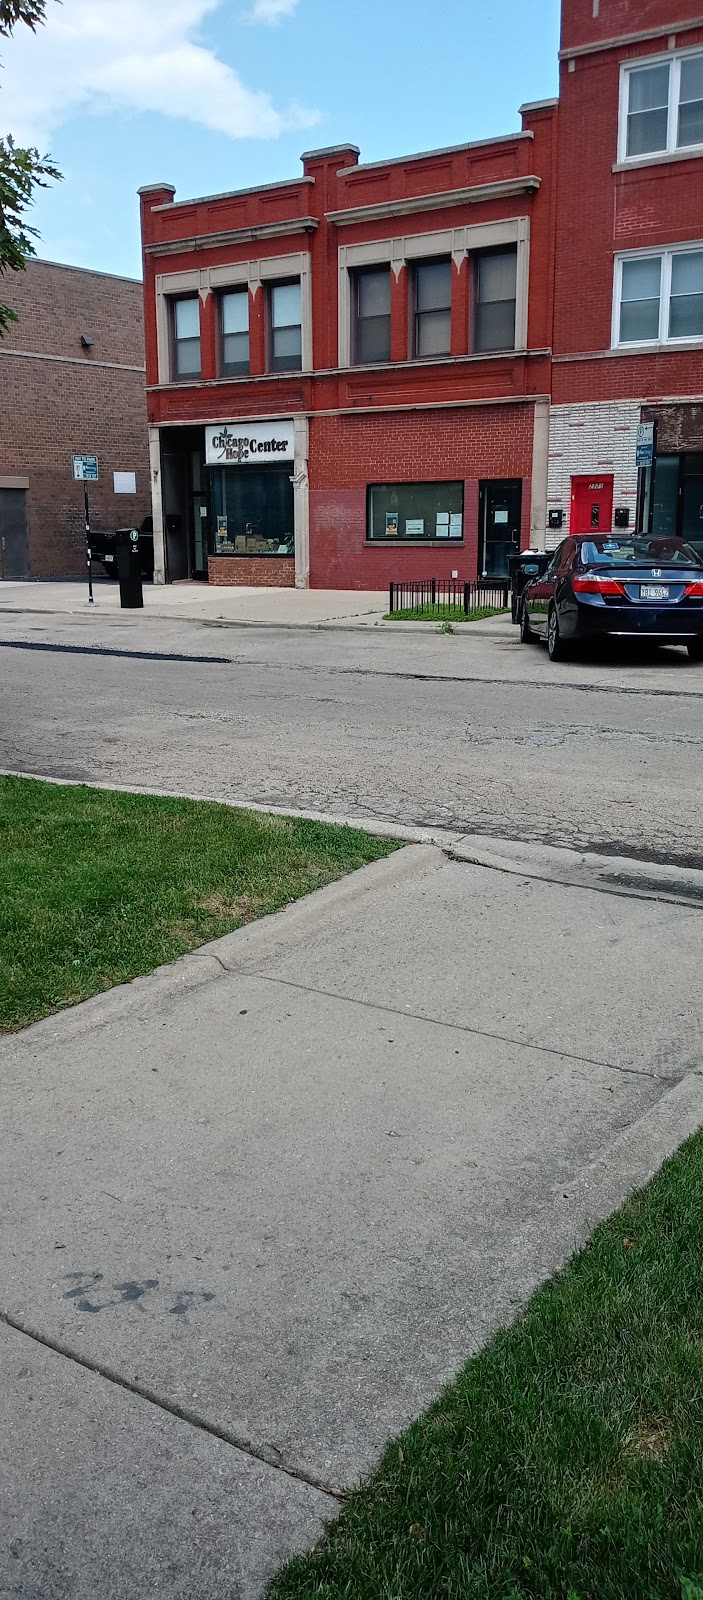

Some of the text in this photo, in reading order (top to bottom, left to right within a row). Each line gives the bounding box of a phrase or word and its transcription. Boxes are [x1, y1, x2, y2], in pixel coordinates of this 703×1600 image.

[212, 435, 249, 450] Chicago
[249, 438, 289, 453] Center
[225, 447, 249, 462] Hope
